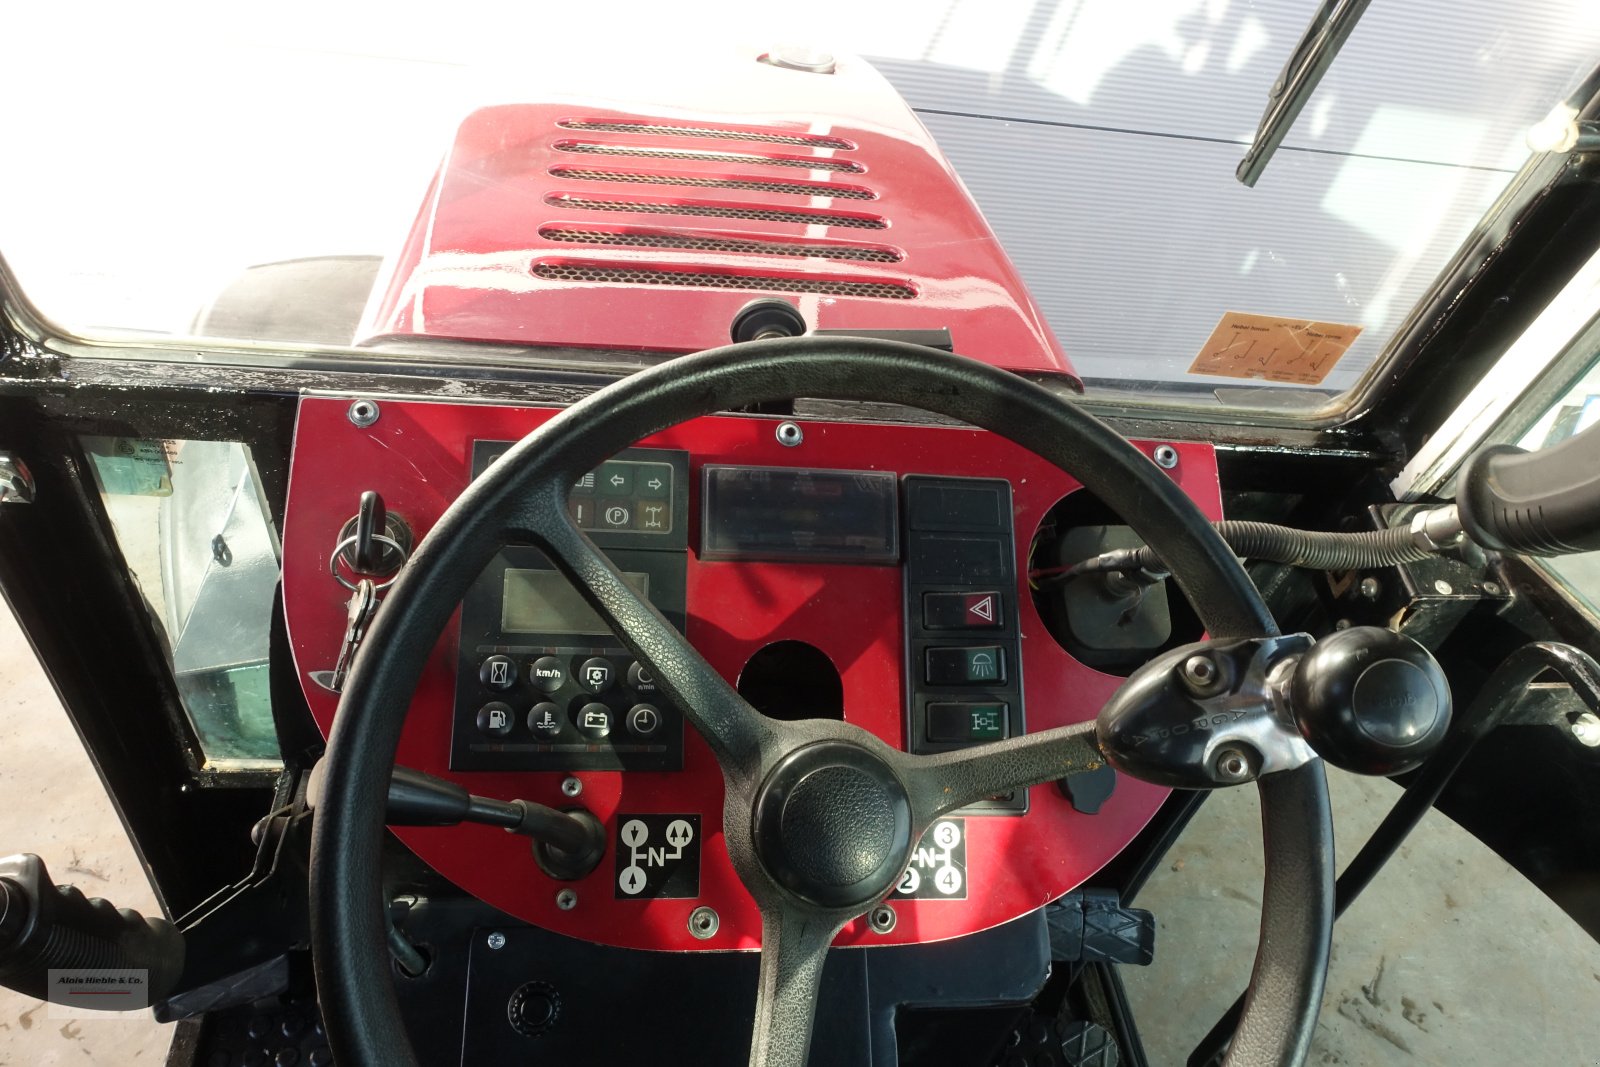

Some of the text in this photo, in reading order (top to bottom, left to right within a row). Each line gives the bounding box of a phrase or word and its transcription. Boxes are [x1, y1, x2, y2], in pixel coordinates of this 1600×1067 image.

[536, 668, 561, 679] km/h
[941, 827, 954, 844] 3
[647, 847, 665, 867] N
[918, 848, 936, 868] N
[900, 870, 913, 890] 2
[942, 871, 955, 889] 4
